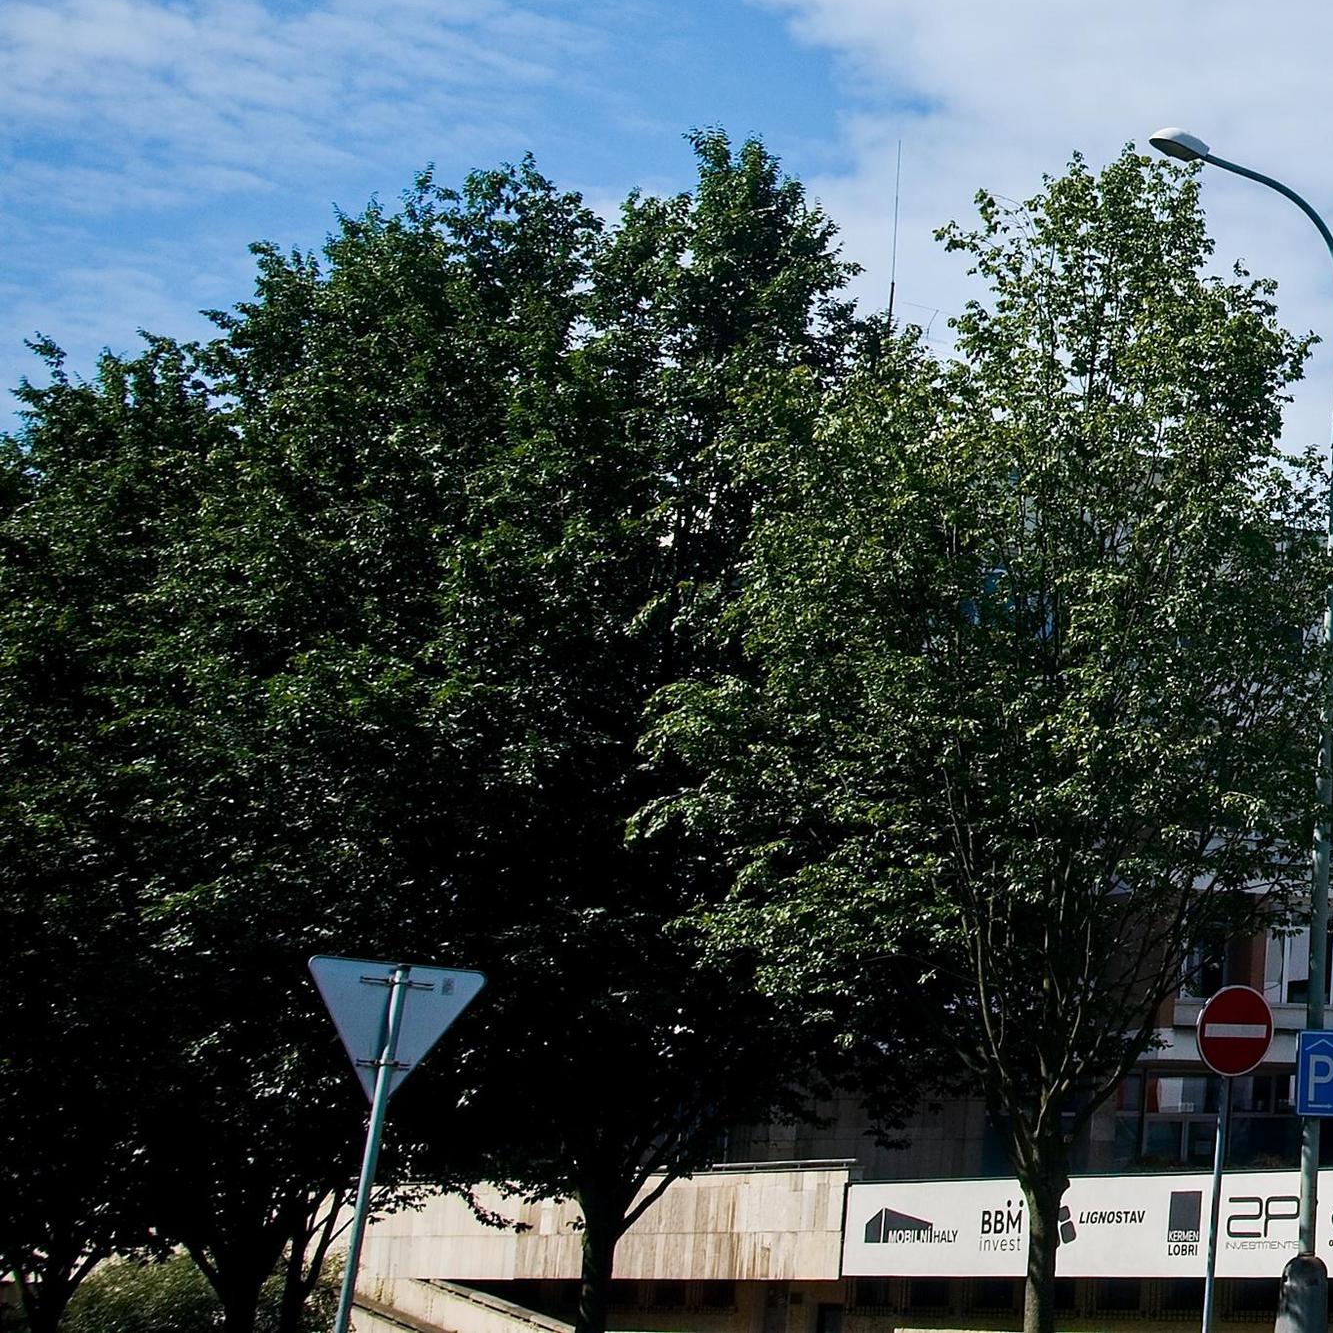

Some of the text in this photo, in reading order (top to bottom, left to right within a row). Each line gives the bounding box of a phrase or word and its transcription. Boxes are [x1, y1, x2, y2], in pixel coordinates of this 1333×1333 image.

[980, 1209, 1023, 1235] BBM
[1079, 1211, 1146, 1224] LIGNOSTAV
[1226, 1196, 1301, 1238] 2P
[979, 1235, 1022, 1252] invest
[1168, 1230, 1200, 1242] KERMEN
[1168, 1244, 1198, 1256] LOBRI
